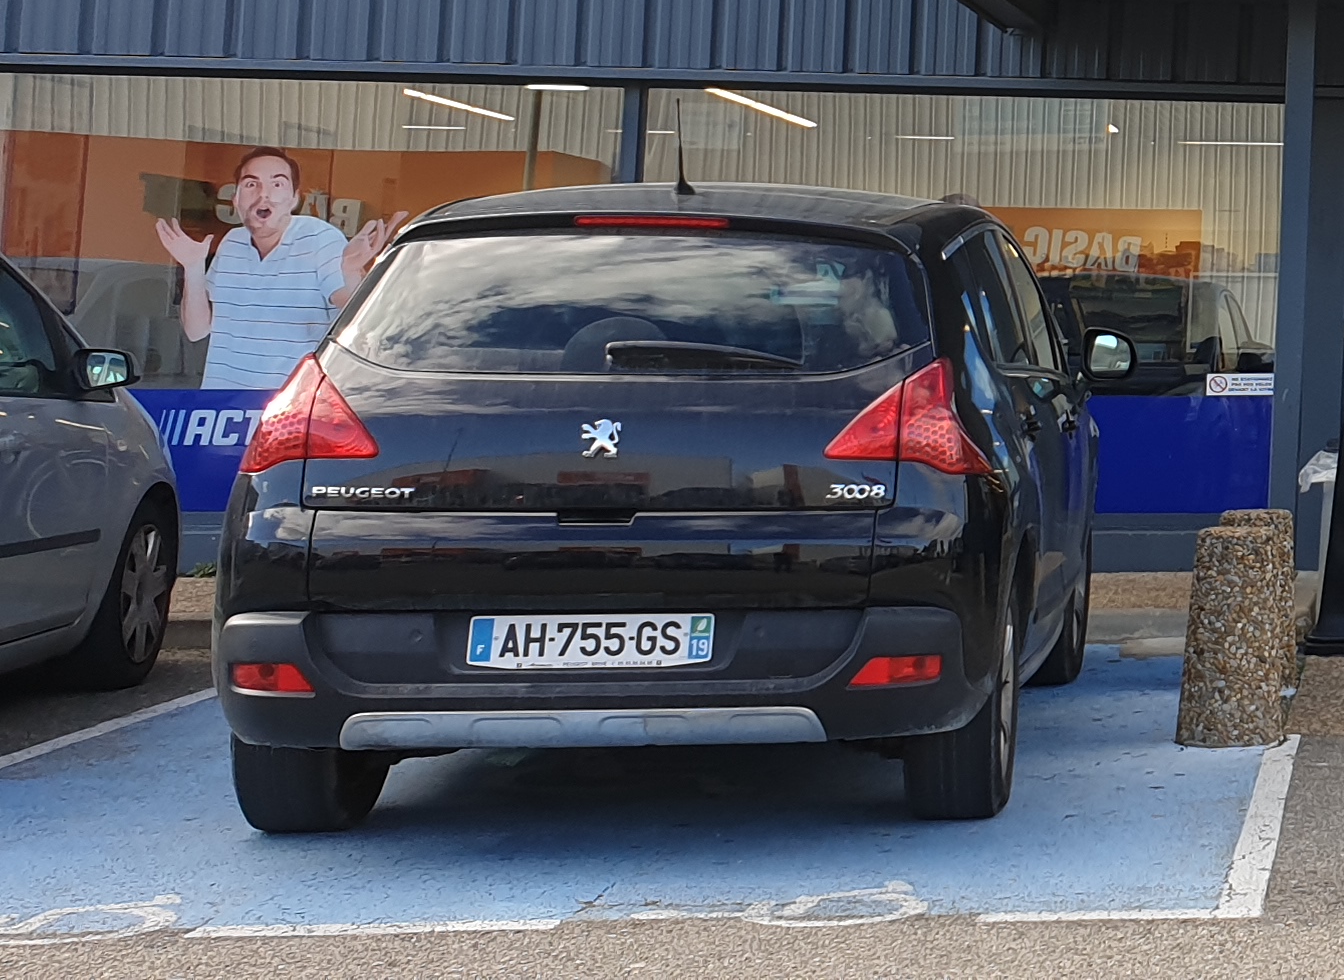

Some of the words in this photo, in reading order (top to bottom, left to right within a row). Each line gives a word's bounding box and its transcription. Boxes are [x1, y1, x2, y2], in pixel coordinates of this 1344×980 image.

[183, 409, 264, 446] ACT
[311, 486, 416, 499] PEUGEOT
[825, 484, 887, 499] 3008
[476, 644, 485, 656] F
[498, 620, 682, 658] AH-755-GS
[690, 639, 708, 656] 19
